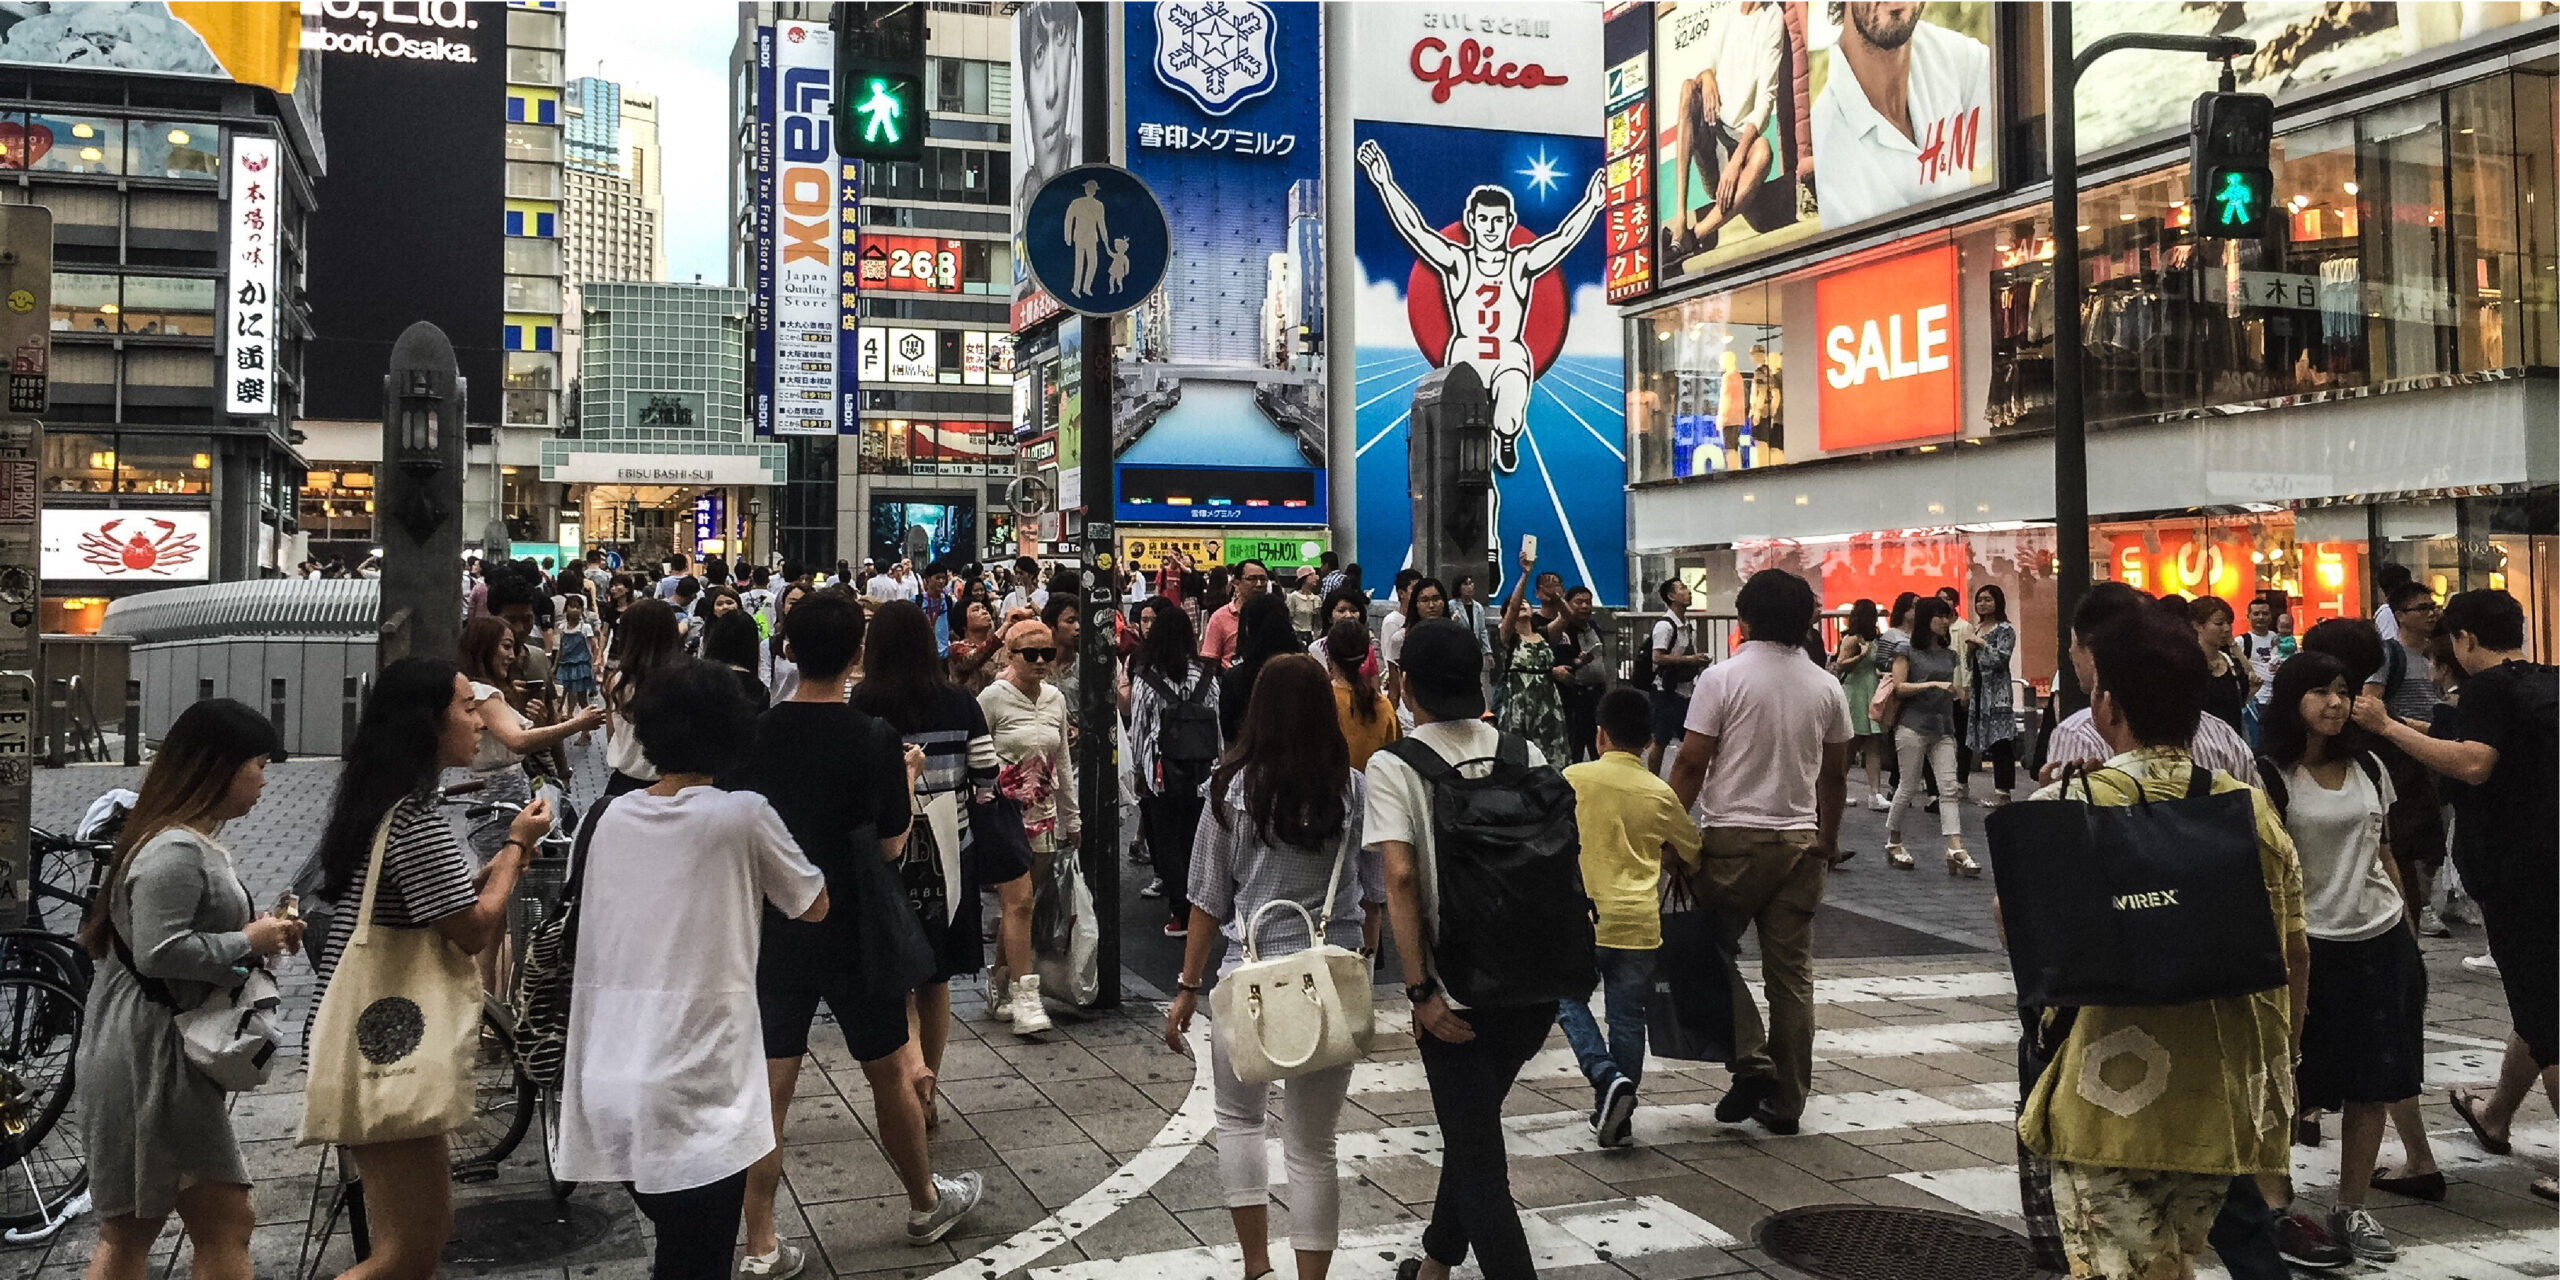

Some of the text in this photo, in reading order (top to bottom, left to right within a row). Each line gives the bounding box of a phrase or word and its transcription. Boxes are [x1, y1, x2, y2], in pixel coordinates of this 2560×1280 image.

[1410, 36, 1568, 104] Glico
[758, 122, 771, 172] Leading
[1138, 122, 1296, 156] 雪印メグミルク
[1917, 106, 1980, 186] H&M
[760, 177, 771, 200] Tax
[1630, 102, 1648, 274] インターネット
[760, 203, 771, 233] Free
[1611, 184, 1629, 280] コミック
[760, 238, 771, 272] Store
[785, 270, 827, 283] Japan
[785, 283, 827, 296] Quality
[758, 293, 770, 331] Japan
[785, 296, 827, 308] Store
[1475, 280, 1503, 360] グリコ
[1826, 303, 1949, 390] SALE
